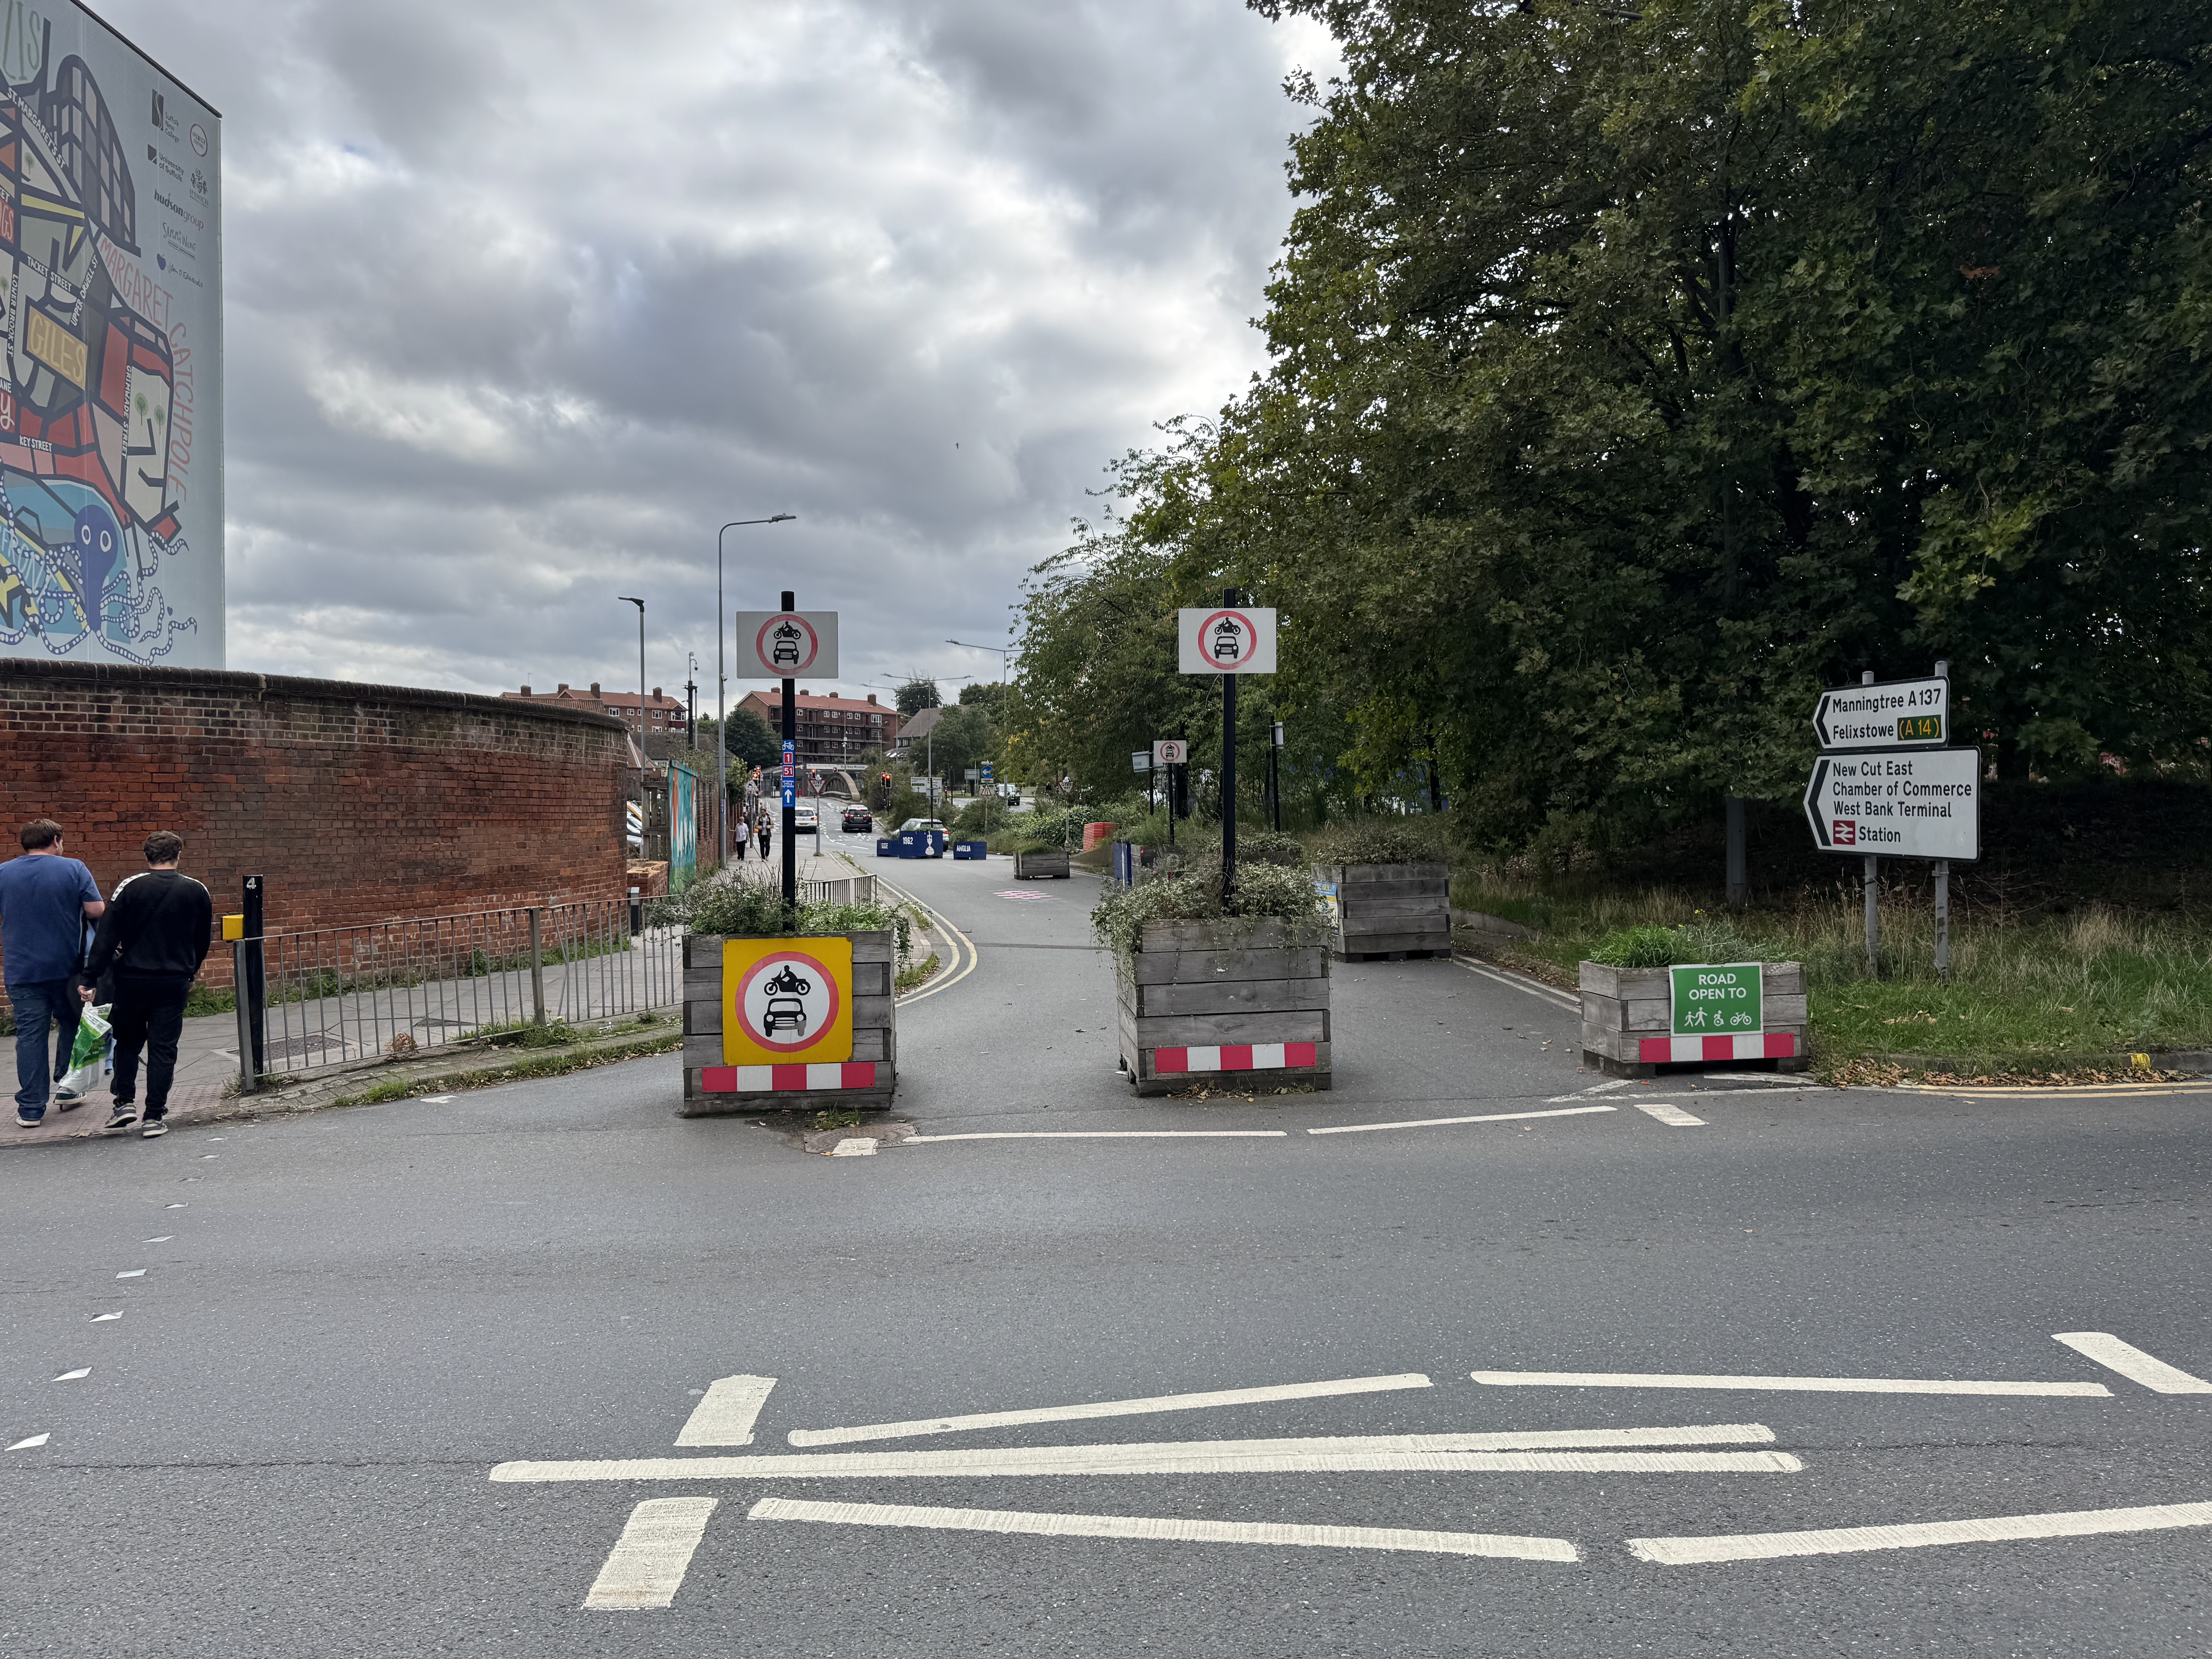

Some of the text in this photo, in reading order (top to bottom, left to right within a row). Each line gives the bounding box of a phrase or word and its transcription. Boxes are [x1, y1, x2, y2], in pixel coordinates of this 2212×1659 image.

[18, 97, 57, 156] MARGARET'S
[57, 154, 65, 168] ST
[159, 152, 184, 175] University
[165, 166, 182, 182] Suffolk
[154, 189, 204, 231] hudsongroup
[0, 200, 14, 240] GS
[27, 256, 72, 292] TACKET STREET
[70, 255, 98, 326] UPPER ORWELL ST
[100, 237, 173, 332] MARGARET
[7, 274, 19, 357] LOWER BROOK ST
[30, 313, 85, 382] GILES
[124, 365, 132, 419] GRIMWADE
[168, 322, 194, 503] CATCHPOLE
[19, 435, 52, 452] KEY STREET
[0, 525, 57, 603] FRONT
[1832, 694, 1904, 713] Manningtree
[1833, 723, 1894, 740] Felixstowe
[786, 754, 790, 762] 1
[1833, 760, 1913, 776] New Cut East
[1833, 780, 1972, 796] Chamber of Commerce
[1834, 801, 1952, 817] West Bank Terminal
[903, 836, 913, 845] 1962
[1859, 826, 1901, 842] Station
[246, 877, 256, 890] 4
[1698, 973, 1736, 985] ROAD
[1689, 987, 1747, 1000] OPEN TO
